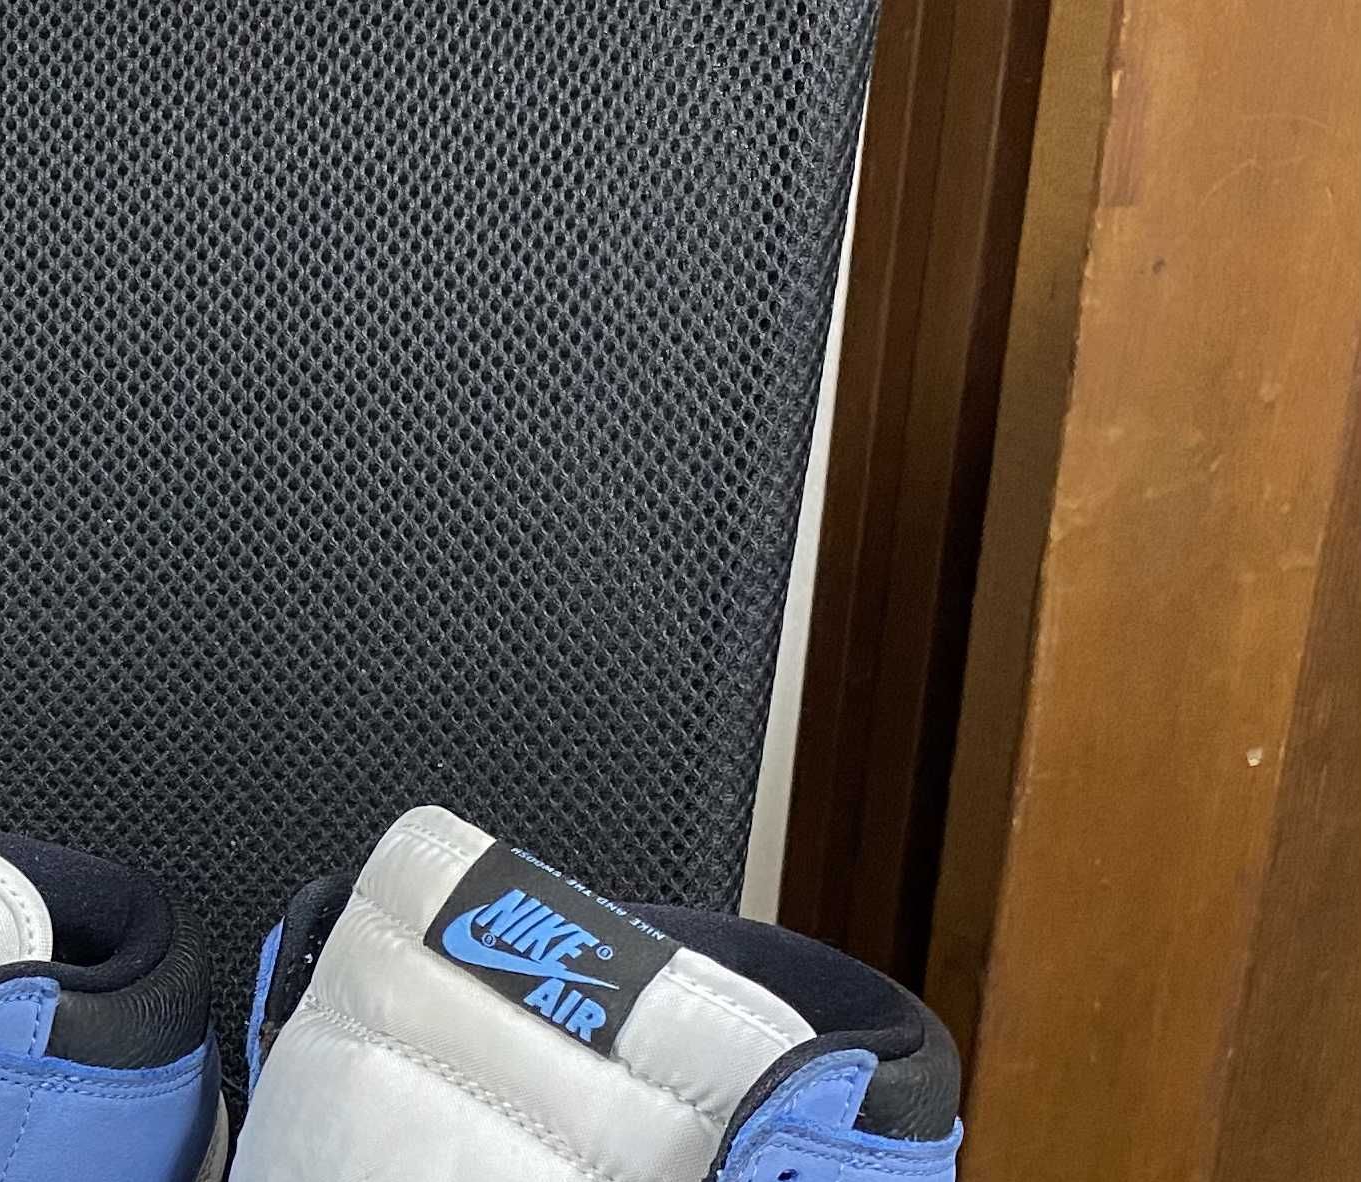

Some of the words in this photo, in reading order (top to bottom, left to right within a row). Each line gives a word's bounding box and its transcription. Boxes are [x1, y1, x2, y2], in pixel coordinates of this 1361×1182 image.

[565, 879, 592, 897] THE
[596, 895, 627, 916] AND
[475, 888, 600, 970] NIKE
[629, 917, 666, 941] NIKE
[523, 977, 607, 1042] AIR
